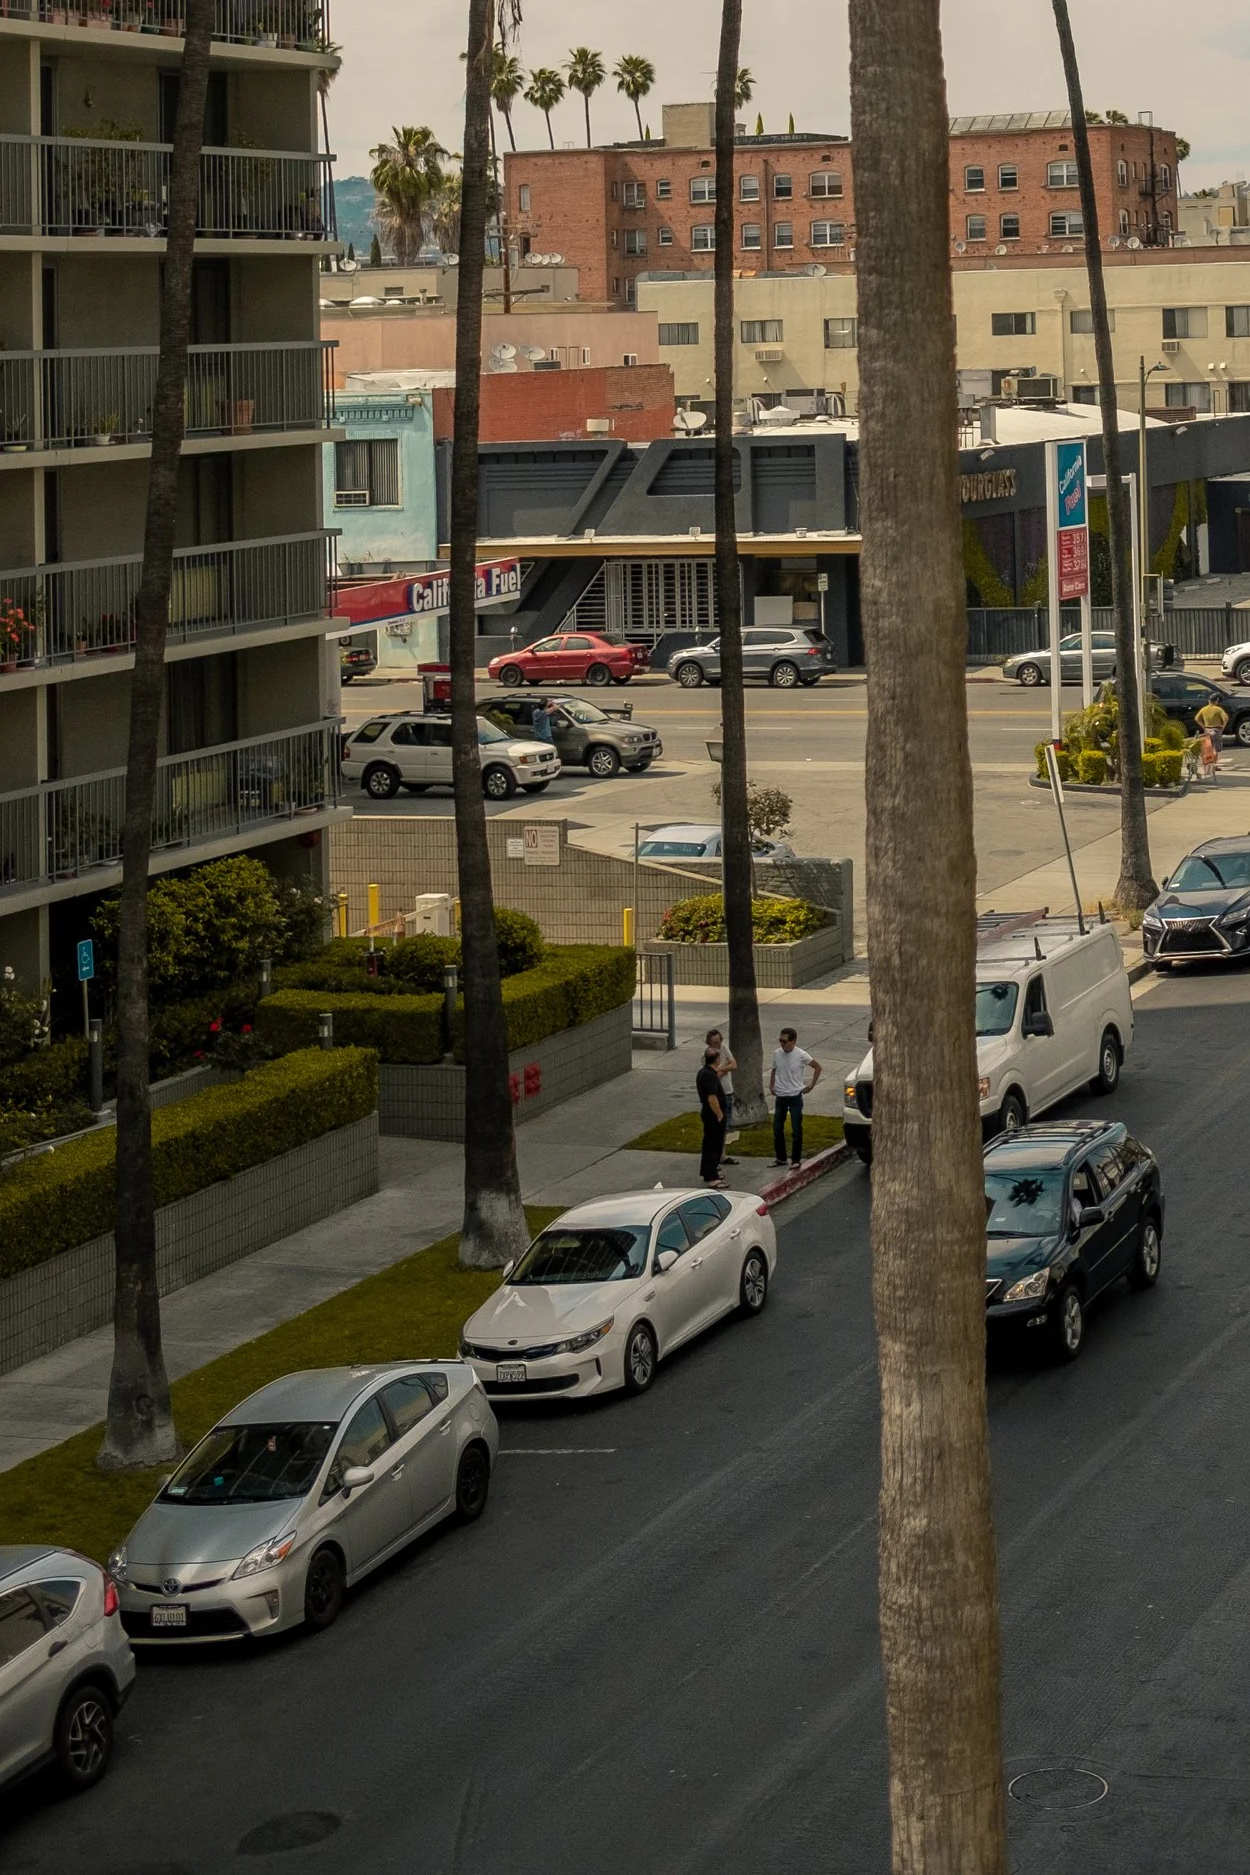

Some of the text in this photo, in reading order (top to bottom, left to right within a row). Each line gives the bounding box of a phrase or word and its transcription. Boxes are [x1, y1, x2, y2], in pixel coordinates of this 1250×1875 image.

[961, 469, 1016, 502] OURGLASS
[1059, 455, 1082, 494] California
[1064, 479, 1082, 515] Fuel
[413, 563, 521, 612] Califa Fuel
[526, 830, 538, 848] NO
